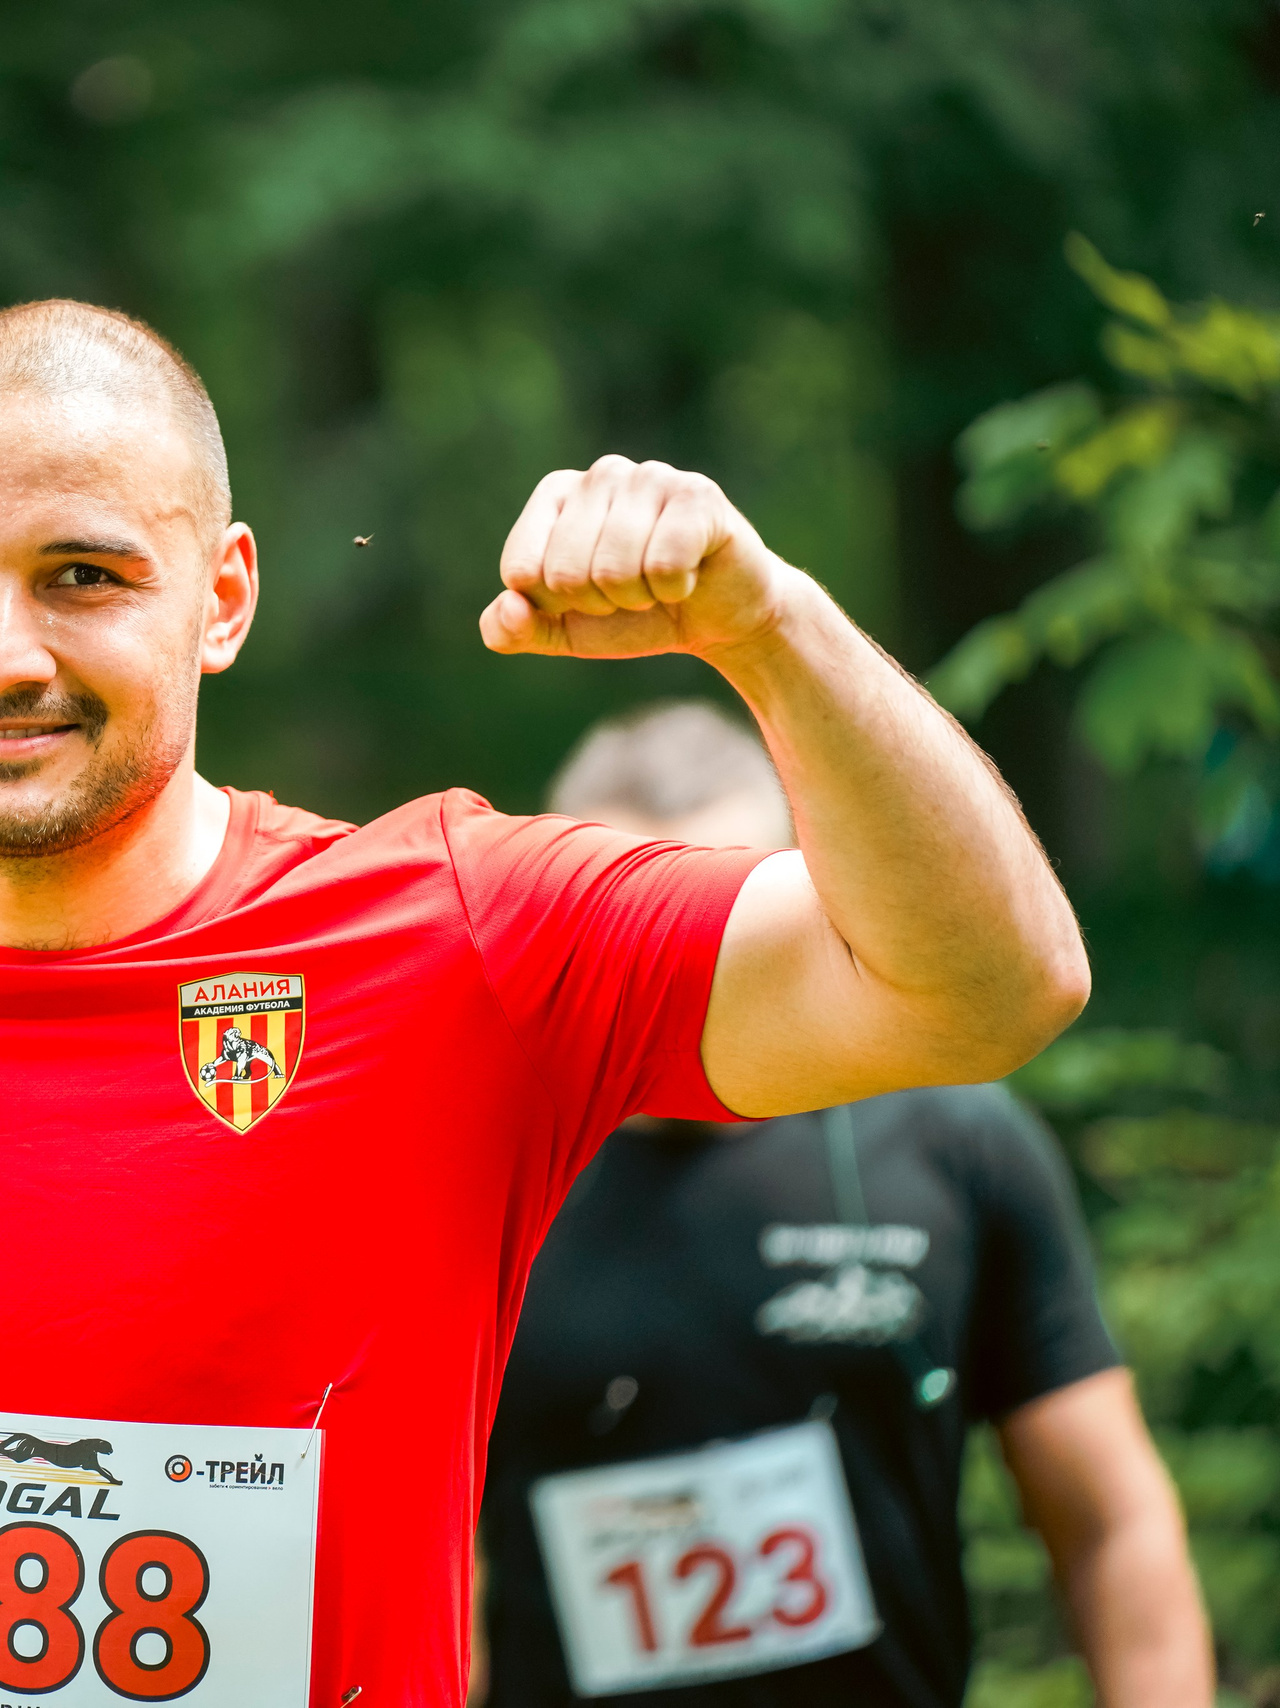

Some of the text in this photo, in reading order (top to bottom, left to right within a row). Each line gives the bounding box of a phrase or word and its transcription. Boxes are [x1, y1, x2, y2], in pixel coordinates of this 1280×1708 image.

[194, 978, 291, 1003] АЛАНИЯ
[194, 1000, 291, 1016] АКАДЕМИЯ ФУТБОЛА
[604, 1525, 830, 1653] 123
